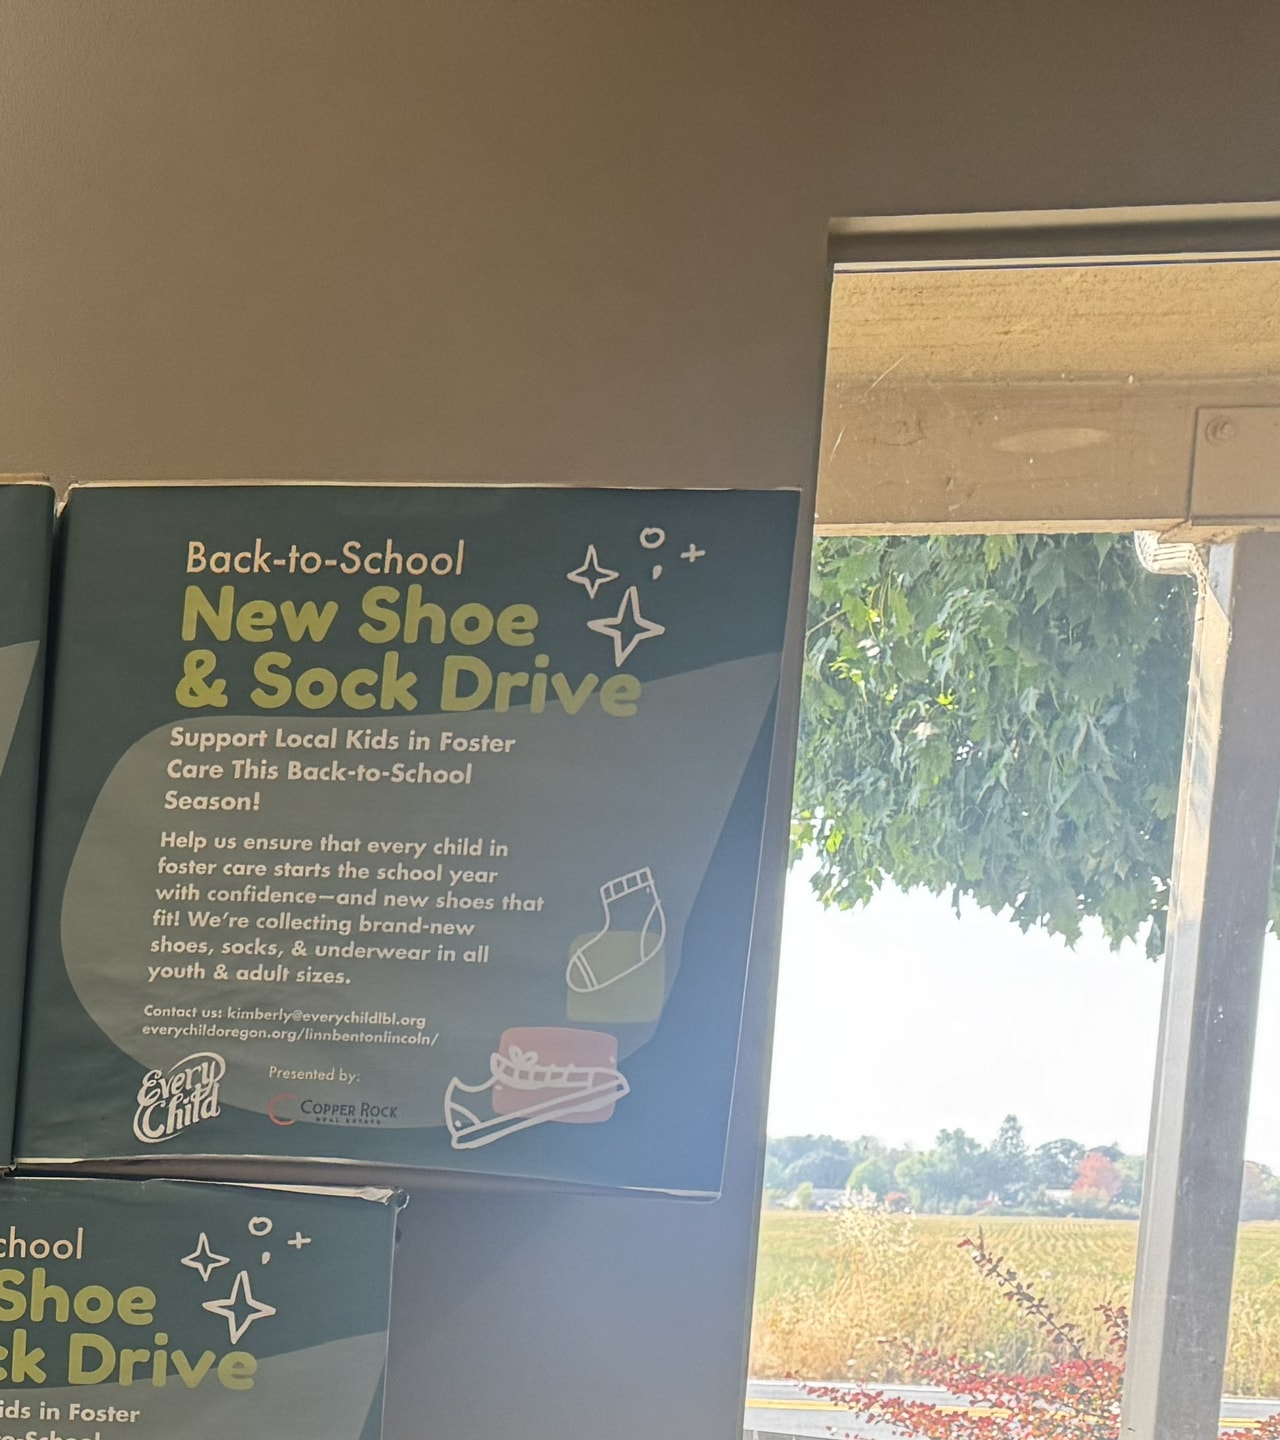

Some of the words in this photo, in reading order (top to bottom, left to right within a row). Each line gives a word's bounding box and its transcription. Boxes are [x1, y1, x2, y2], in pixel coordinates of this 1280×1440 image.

[187, 536, 465, 576] Back-to-School
[182, 584, 338, 642] New
[357, 583, 539, 647] Shoe
[175, 648, 228, 708] &
[250, 650, 418, 711] Sock
[439, 654, 643, 718] Drive
[170, 726, 268, 752] Support
[275, 727, 338, 748] Local
[345, 728, 399, 750] Kids
[408, 729, 430, 751] in
[439, 731, 516, 753] Foster
[152, 907, 180, 926] fit!
[187, 910, 249, 928] We're
[256, 911, 352, 936] collecting
[358, 914, 476, 935] brand-new
[67, 1332, 258, 1392] Drive
